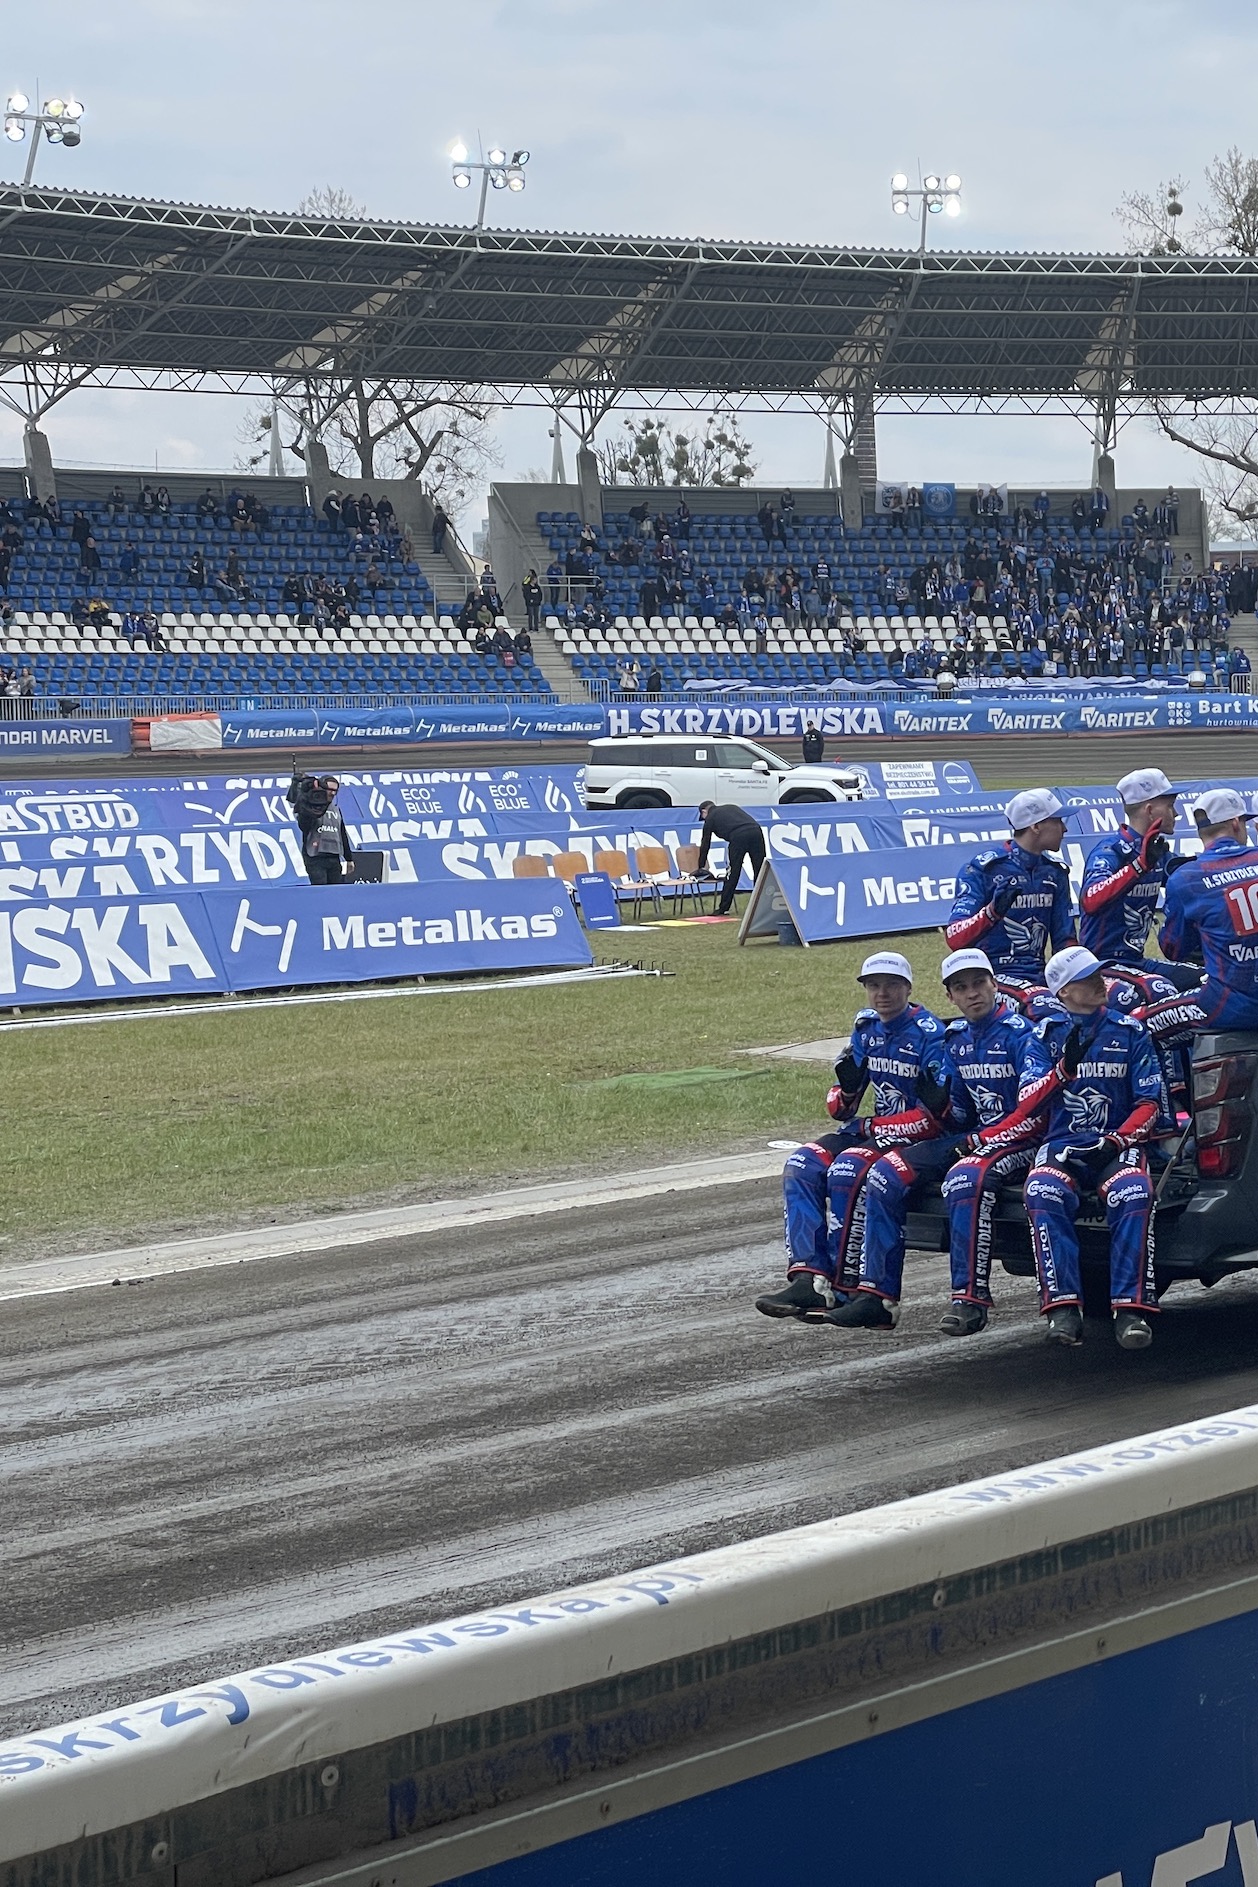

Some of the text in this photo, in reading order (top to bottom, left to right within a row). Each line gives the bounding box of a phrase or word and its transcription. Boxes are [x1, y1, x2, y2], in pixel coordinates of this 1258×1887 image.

[1199, 700, 1241, 714] Bart
[895, 710, 973, 732] VARITEX
[988, 708, 1065, 730] VARITEX
[1081, 706, 1158, 728] VARITEX
[1207, 717, 1258, 727] hurtownia
[247, 727, 314, 739] Metalkas
[344, 725, 410, 738] Metalkas
[439, 723, 506, 734] Metalkas
[535, 721, 602, 733] Metalkas
[42, 729, 113, 745] MARVEL
[400, 787, 430, 801] ECO
[488, 784, 518, 798] ECO
[406, 801, 444, 815] BLUE
[495, 797, 531, 811] BLUE
[326, 810, 338, 820] TV
[874, 1117, 930, 1137] BECKHOFF
[1038, 1222, 1059, 1292] MAX-POL
